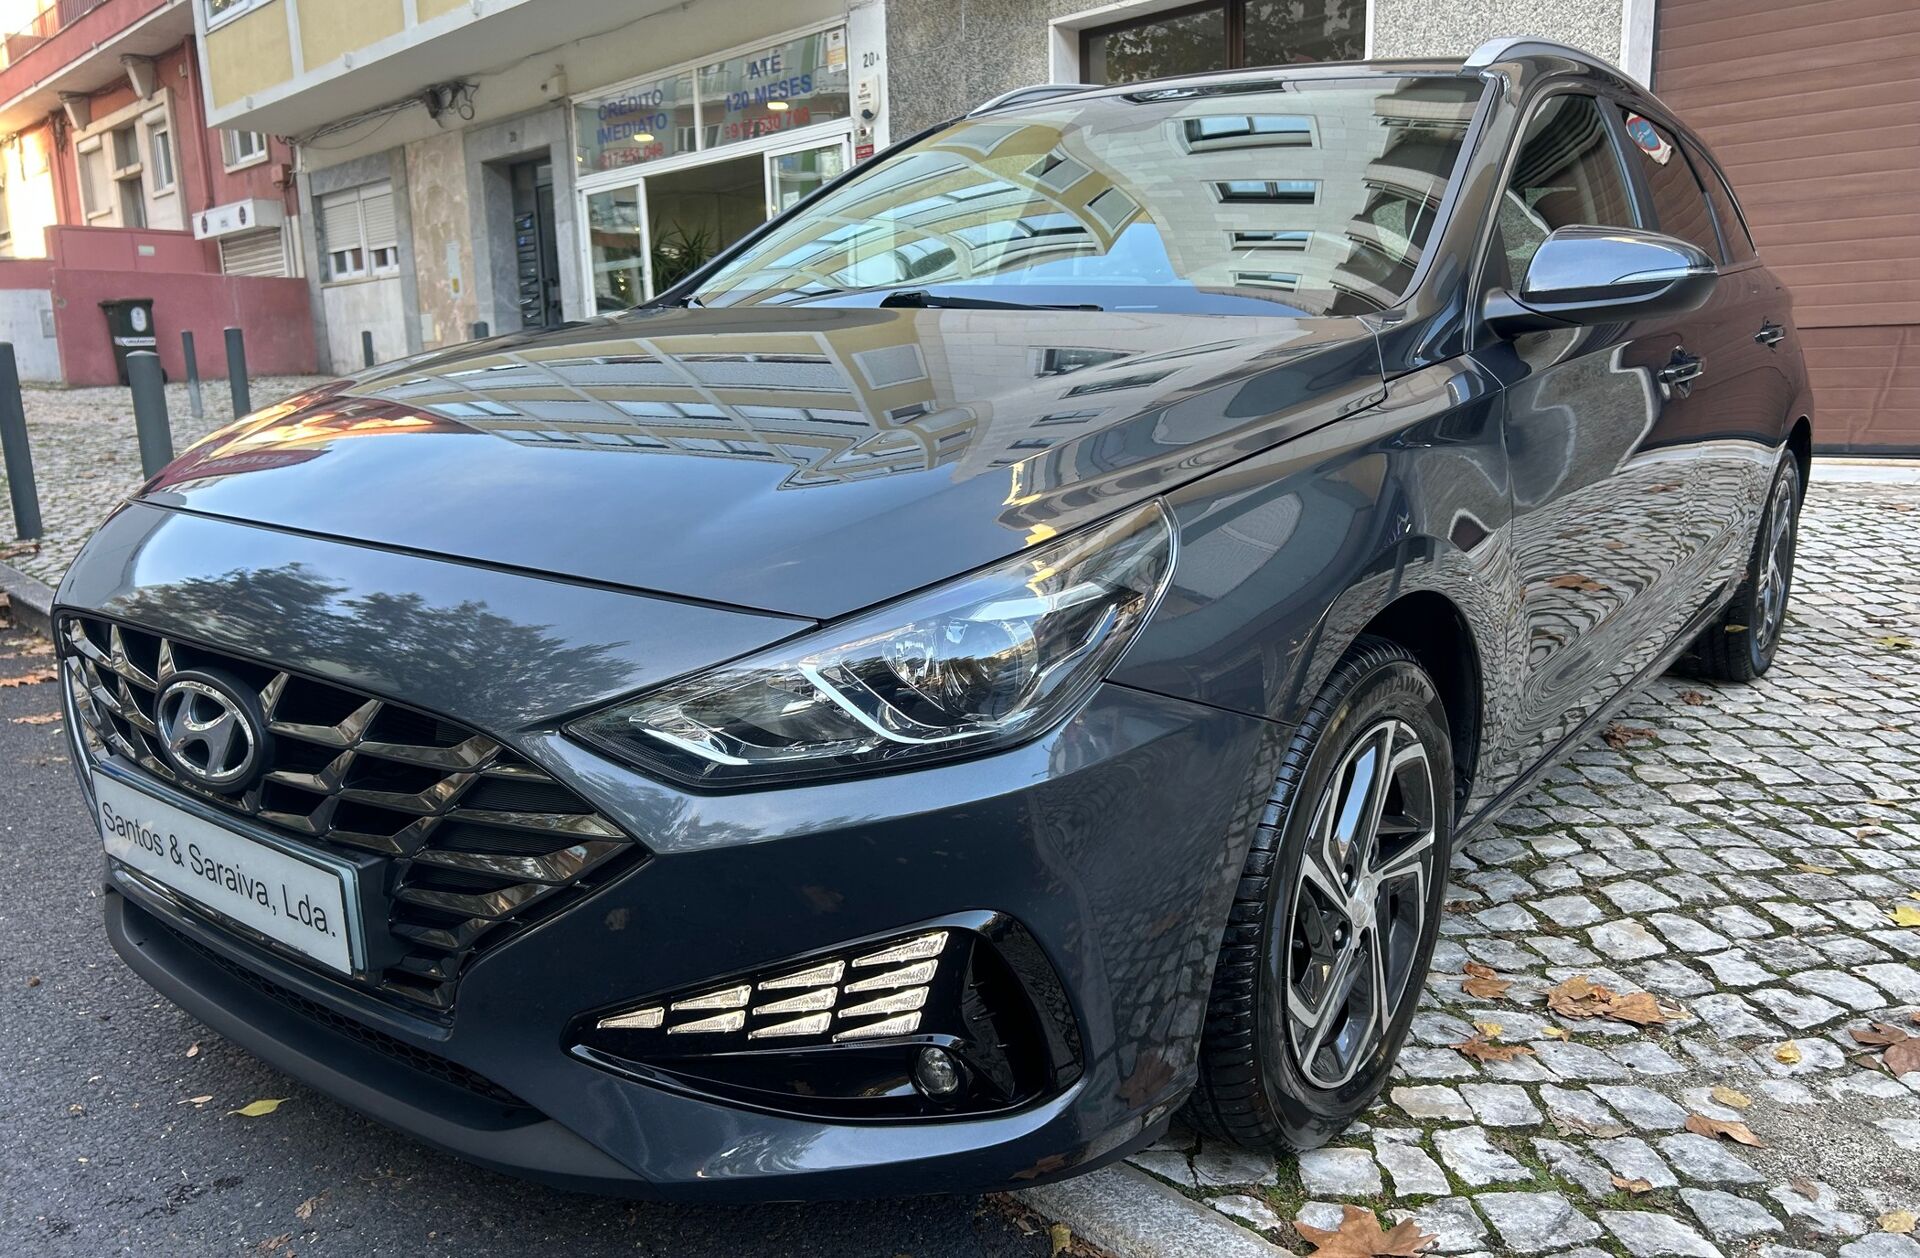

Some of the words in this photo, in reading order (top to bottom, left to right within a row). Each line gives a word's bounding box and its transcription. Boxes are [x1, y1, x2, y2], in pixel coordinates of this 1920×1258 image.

[749, 49, 781, 80] ATÉ
[863, 52, 874, 68] 20
[598, 89, 663, 121] CRÉDITO
[726, 90, 749, 113] 120
[755, 74, 812, 105] MESES
[597, 112, 668, 145] IMEDIATO
[102, 802, 164, 857] Santos
[169, 834, 185, 867] &
[188, 843, 277, 916] Saraiva,
[282, 884, 337, 937] Lda.
